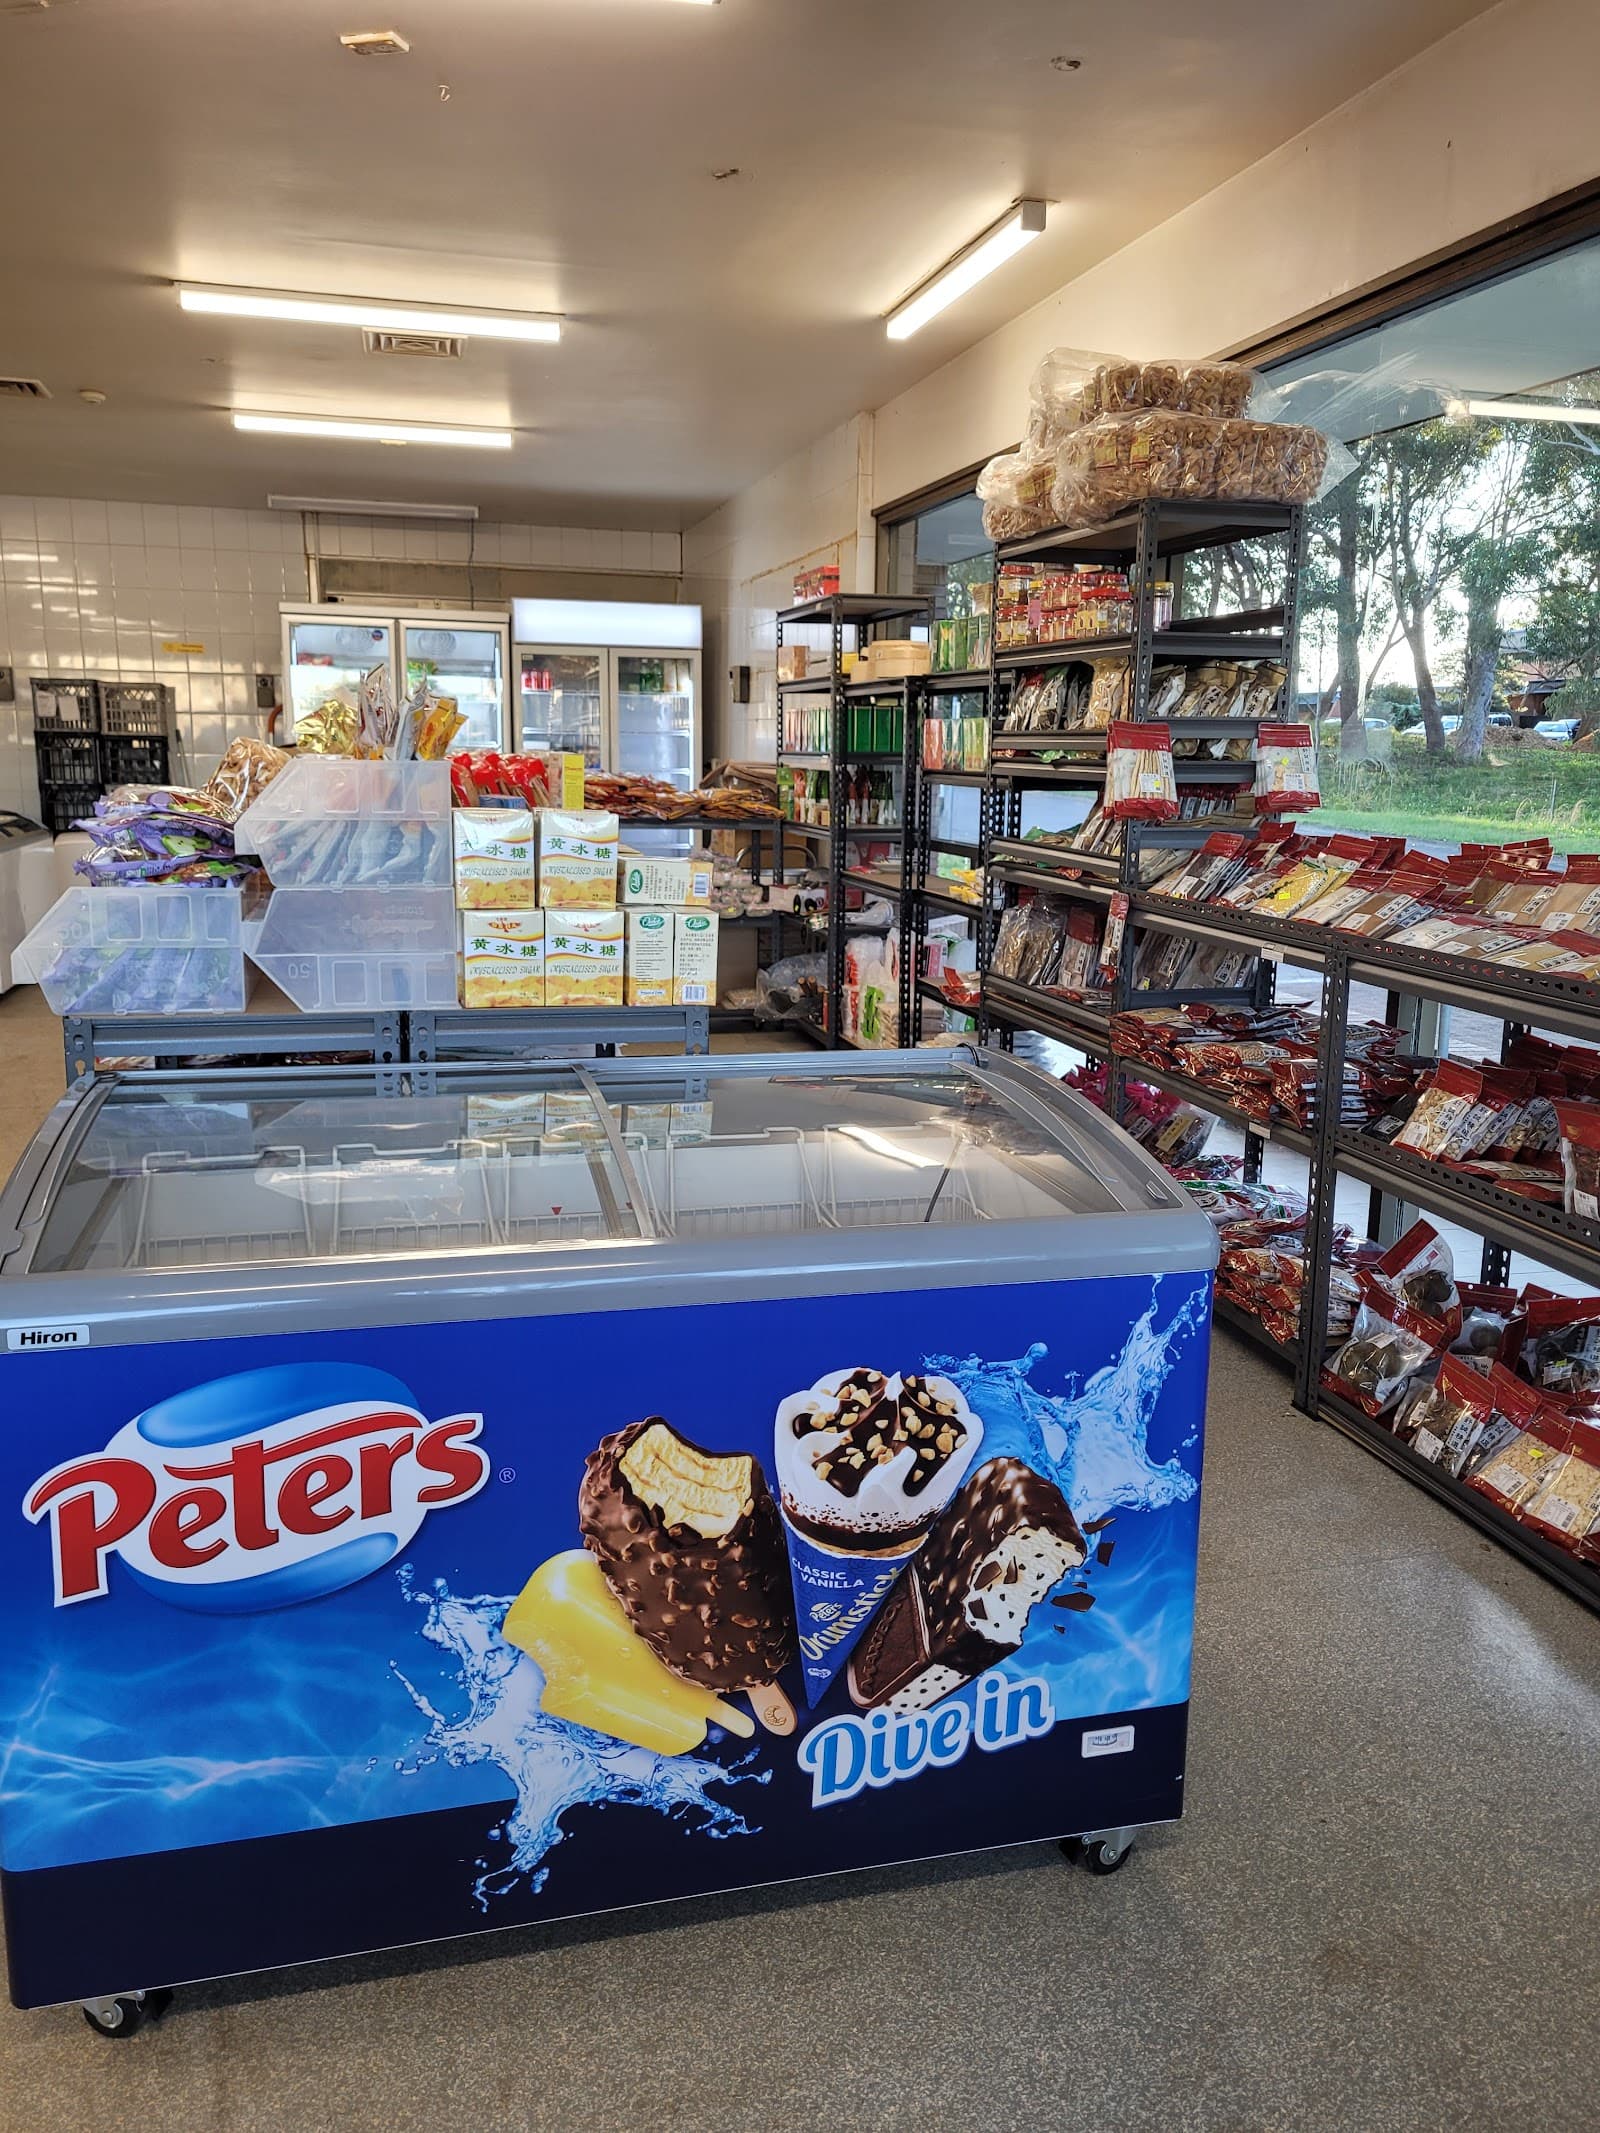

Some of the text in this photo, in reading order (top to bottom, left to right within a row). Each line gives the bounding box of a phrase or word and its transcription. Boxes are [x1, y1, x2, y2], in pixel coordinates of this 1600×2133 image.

[461, 838, 528, 859] 冰糖
[547, 837, 613, 860] 黄冰糖
[510, 867, 531, 877] SUGAR
[592, 866, 613, 876] SUGAR
[470, 938, 539, 958] 黄冰糖
[552, 937, 618, 957] 黄冰糖
[520, 966, 541, 975] SUGAR
[598, 964, 619, 974] SUGAR
[20, 1331, 77, 1345] Hiron
[26, 1409, 486, 1602] Peters
[791, 1557, 847, 1580] CLASSIC
[800, 1573, 865, 1589] VANILLA
[809, 1602, 842, 1622] Peters
[804, 1677, 1048, 1797] Dive in
